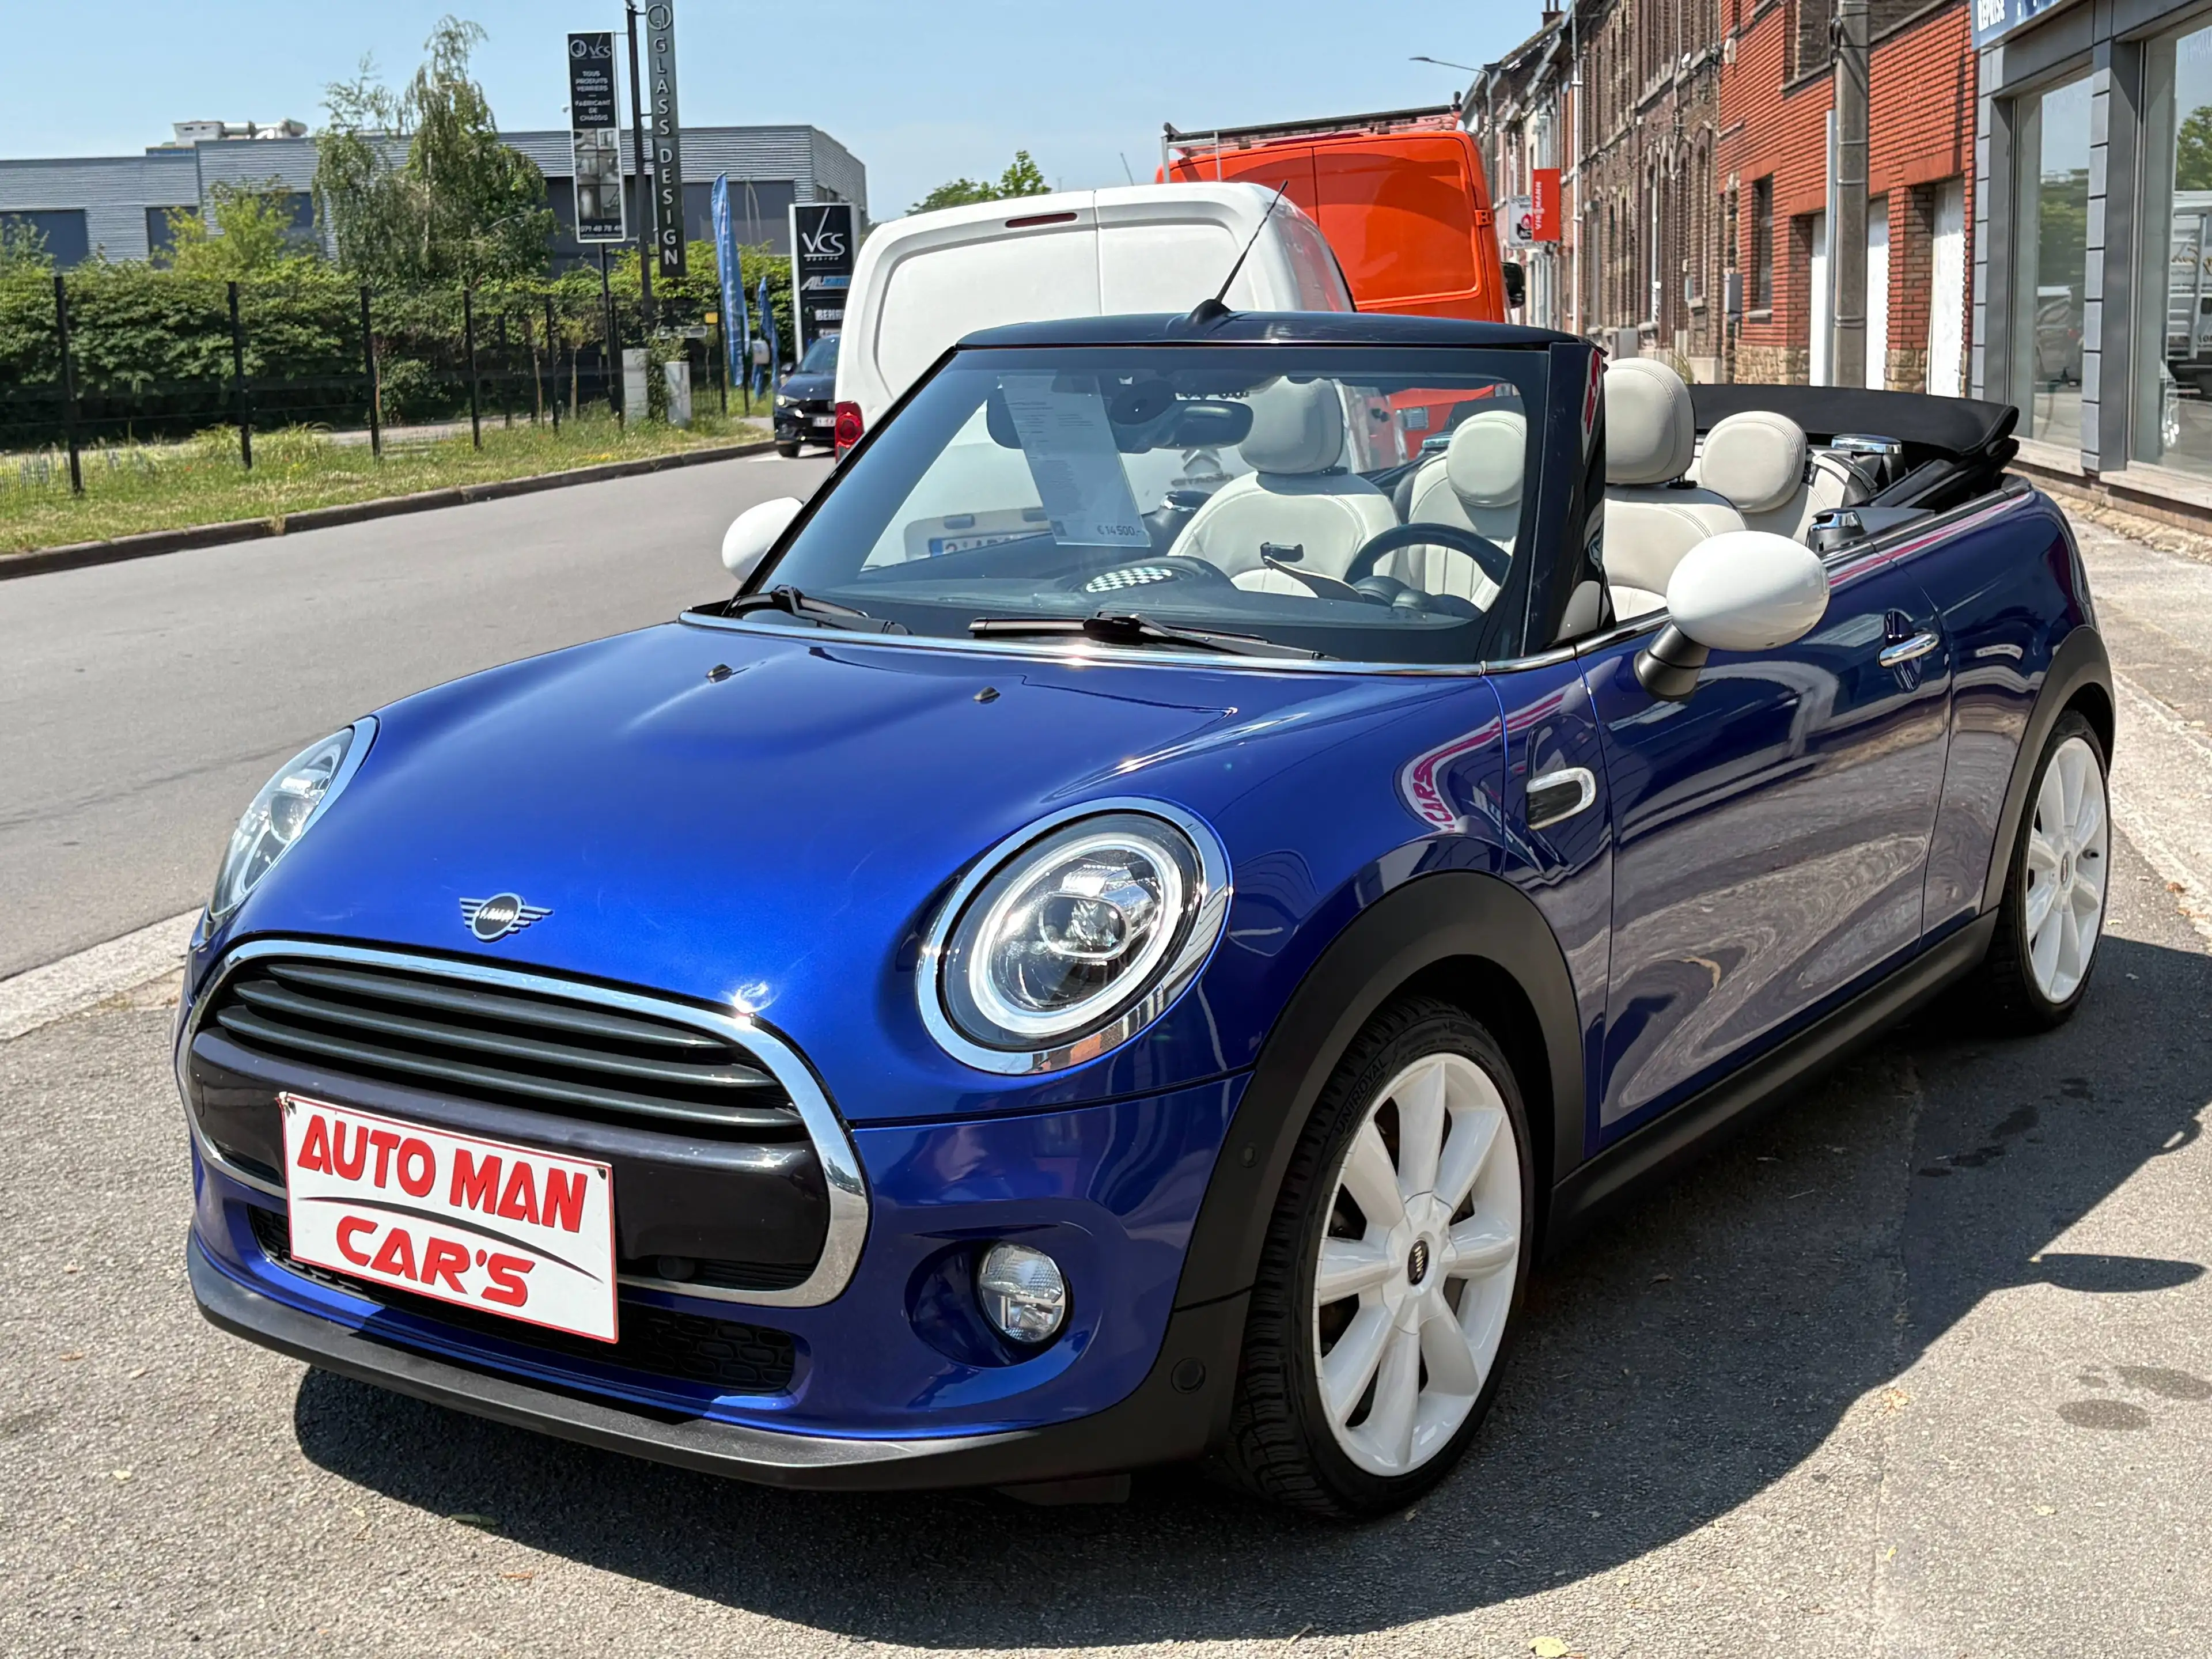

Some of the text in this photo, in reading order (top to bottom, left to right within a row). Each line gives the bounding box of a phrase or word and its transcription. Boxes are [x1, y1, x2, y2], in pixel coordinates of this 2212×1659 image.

[654, 37, 670, 135] GLASS
[660, 148, 678, 265] DESIGN
[801, 207, 846, 257] VCS
[1335, 1058, 1389, 1135] UNIROYAL
[297, 1115, 588, 1233] AUTO MAN
[336, 1215, 535, 1308] CAR'S
